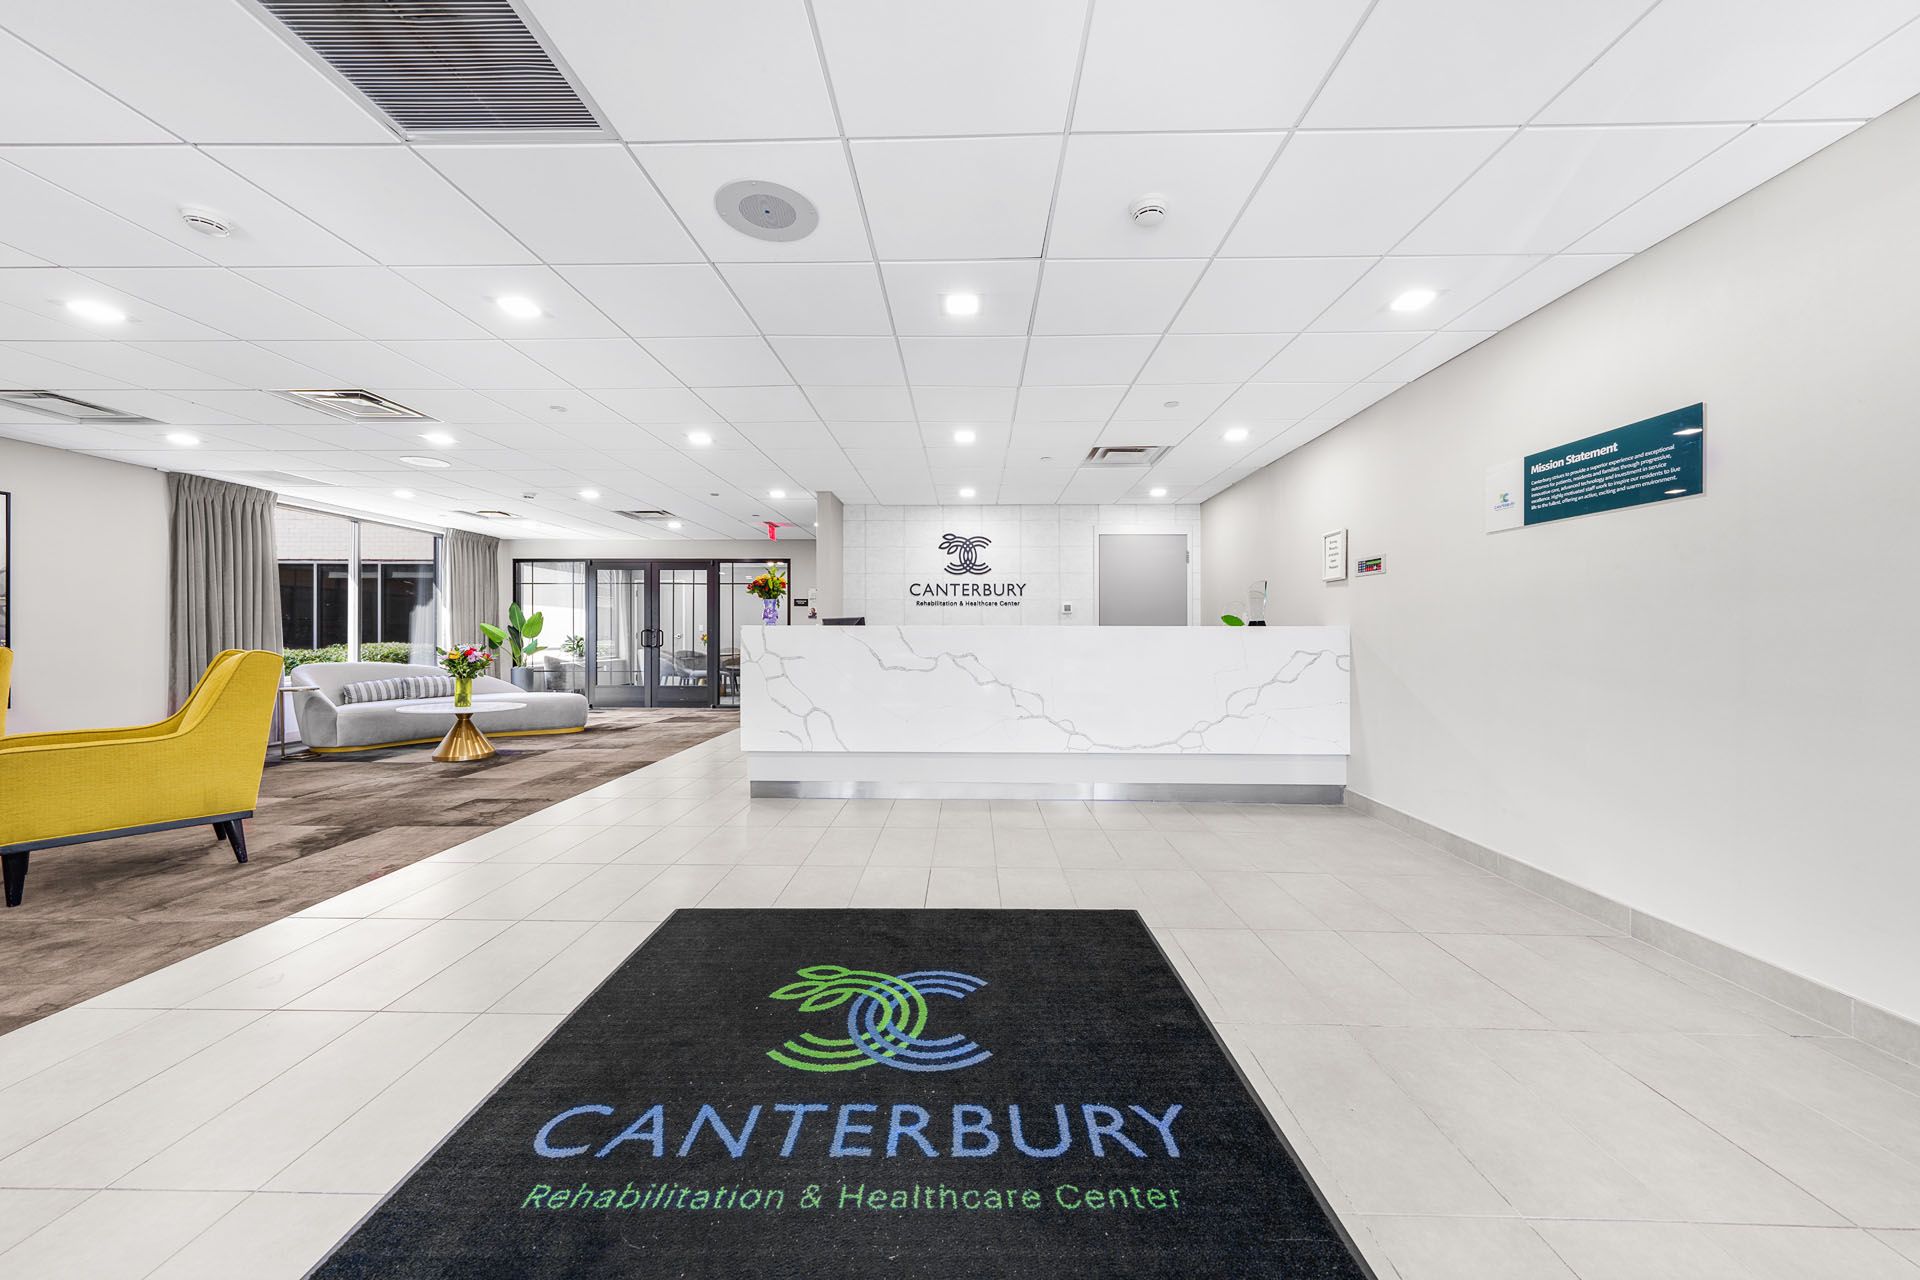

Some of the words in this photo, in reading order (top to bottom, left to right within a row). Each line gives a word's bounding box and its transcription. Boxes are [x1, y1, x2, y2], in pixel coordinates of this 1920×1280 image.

[1531, 460, 1564, 474] Mission
[1566, 443, 1617, 464] Statement
[1570, 468, 1588, 476] provide
[1609, 456, 1634, 465] experience
[1645, 444, 1674, 456] exceptional
[1620, 461, 1640, 469] through
[1641, 454, 1671, 466] progressive,
[1561, 482, 1580, 491] advanced
[1581, 478, 1604, 486] technology
[1614, 468, 1642, 478] investment
[1564, 488, 1585, 496] motivated
[1640, 471, 1663, 479] residents
[1642, 476, 1677, 486] environment.
[910, 583, 1026, 597] CANTERBURY
[533, 1104, 1183, 1158] CANTERBURY
[520, 1181, 786, 1211] Rehabilitation
[799, 1184, 822, 1210] &
[837, 1184, 1042, 1211] Healthcare
[1055, 1184, 1181, 1211] Center
